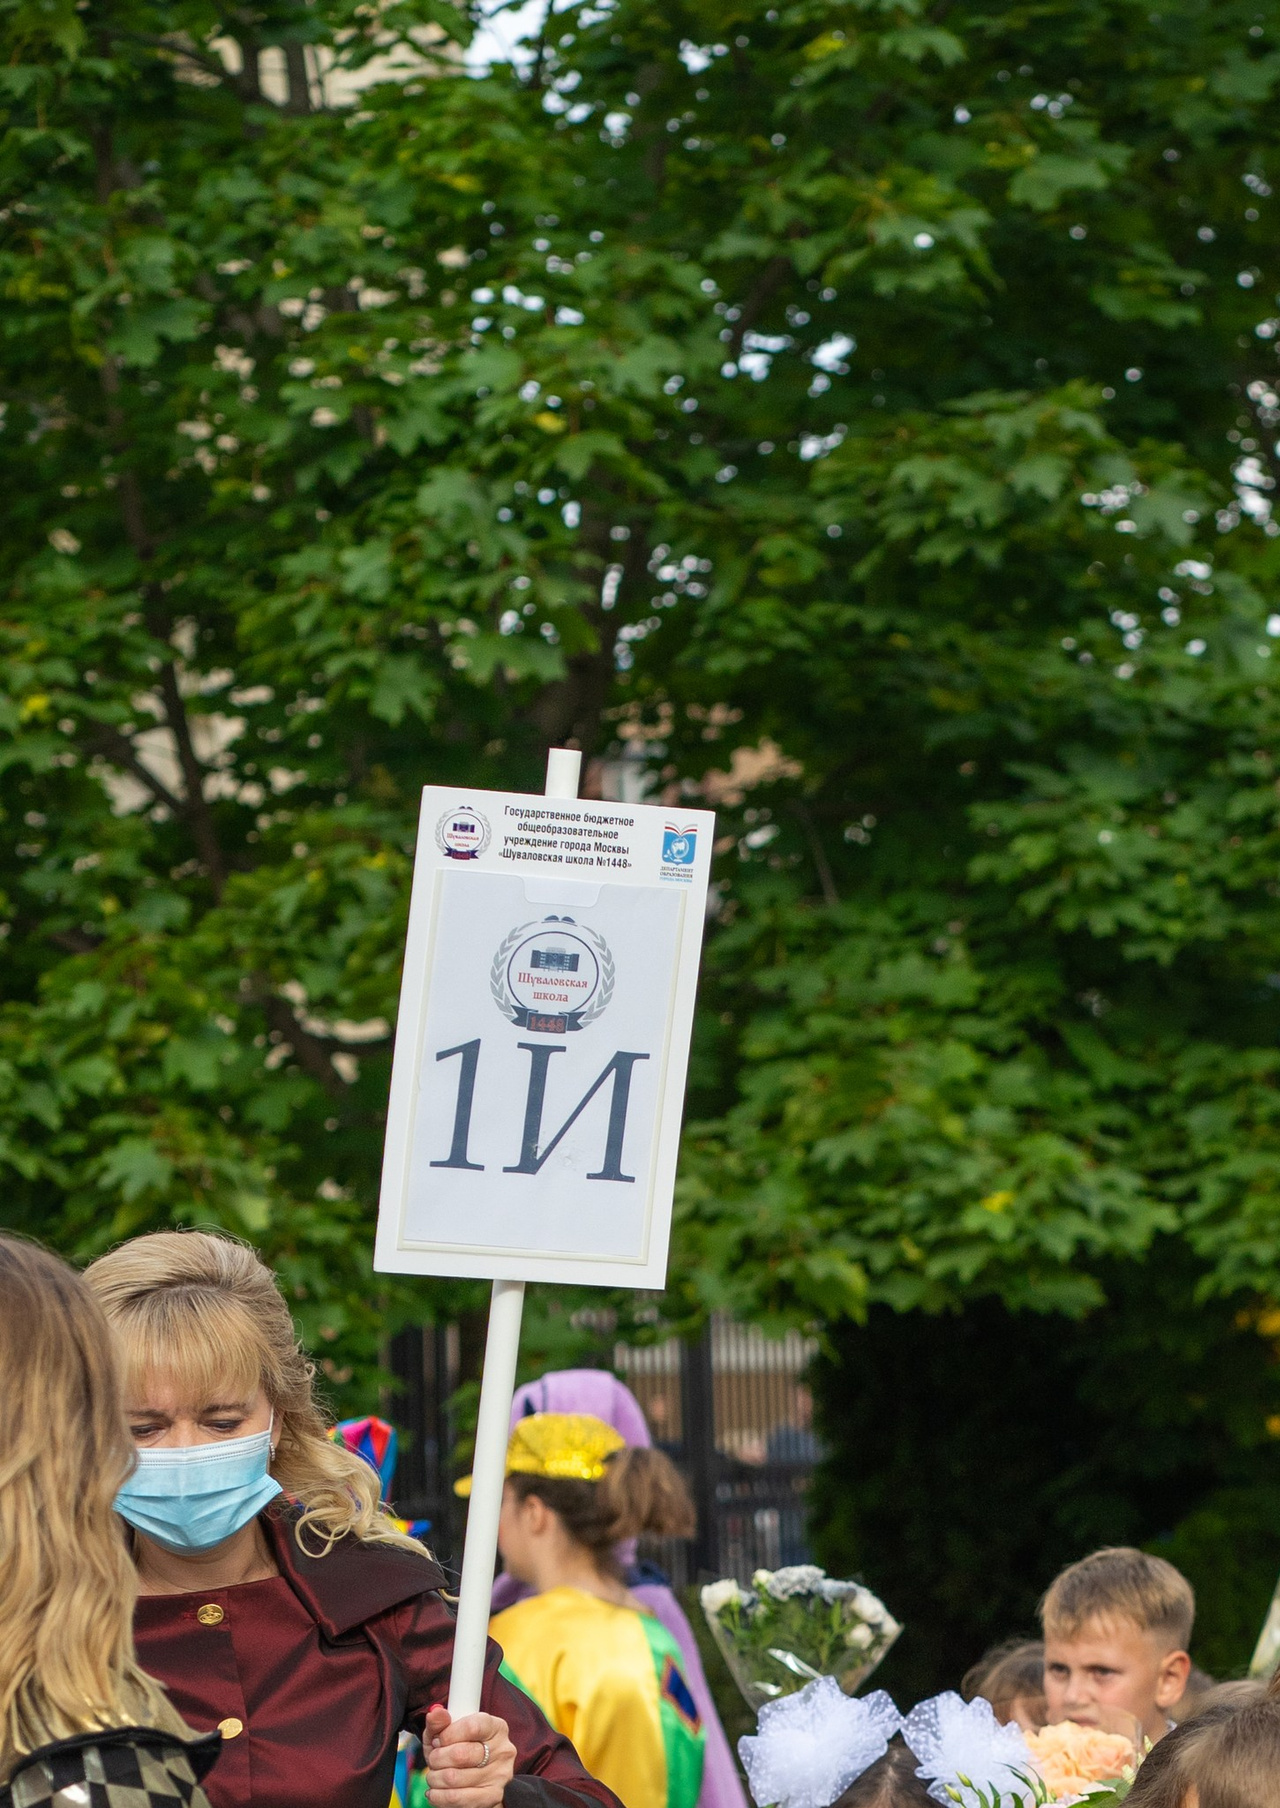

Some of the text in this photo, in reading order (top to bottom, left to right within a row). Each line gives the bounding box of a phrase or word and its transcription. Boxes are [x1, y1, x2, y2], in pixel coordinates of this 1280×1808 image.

[504, 805, 634, 827] Государственное бюджетное
[517, 822, 619, 839] общеобразовательное
[503, 835, 629, 855] учреждение города Москвы
[498, 848, 632, 869] «Шуваловская школа №1448»
[518, 972, 588, 988] Шуваловская
[533, 992, 568, 1002] школа
[529, 1016, 565, 1031] 1448
[430, 1038, 650, 1183] 1И
